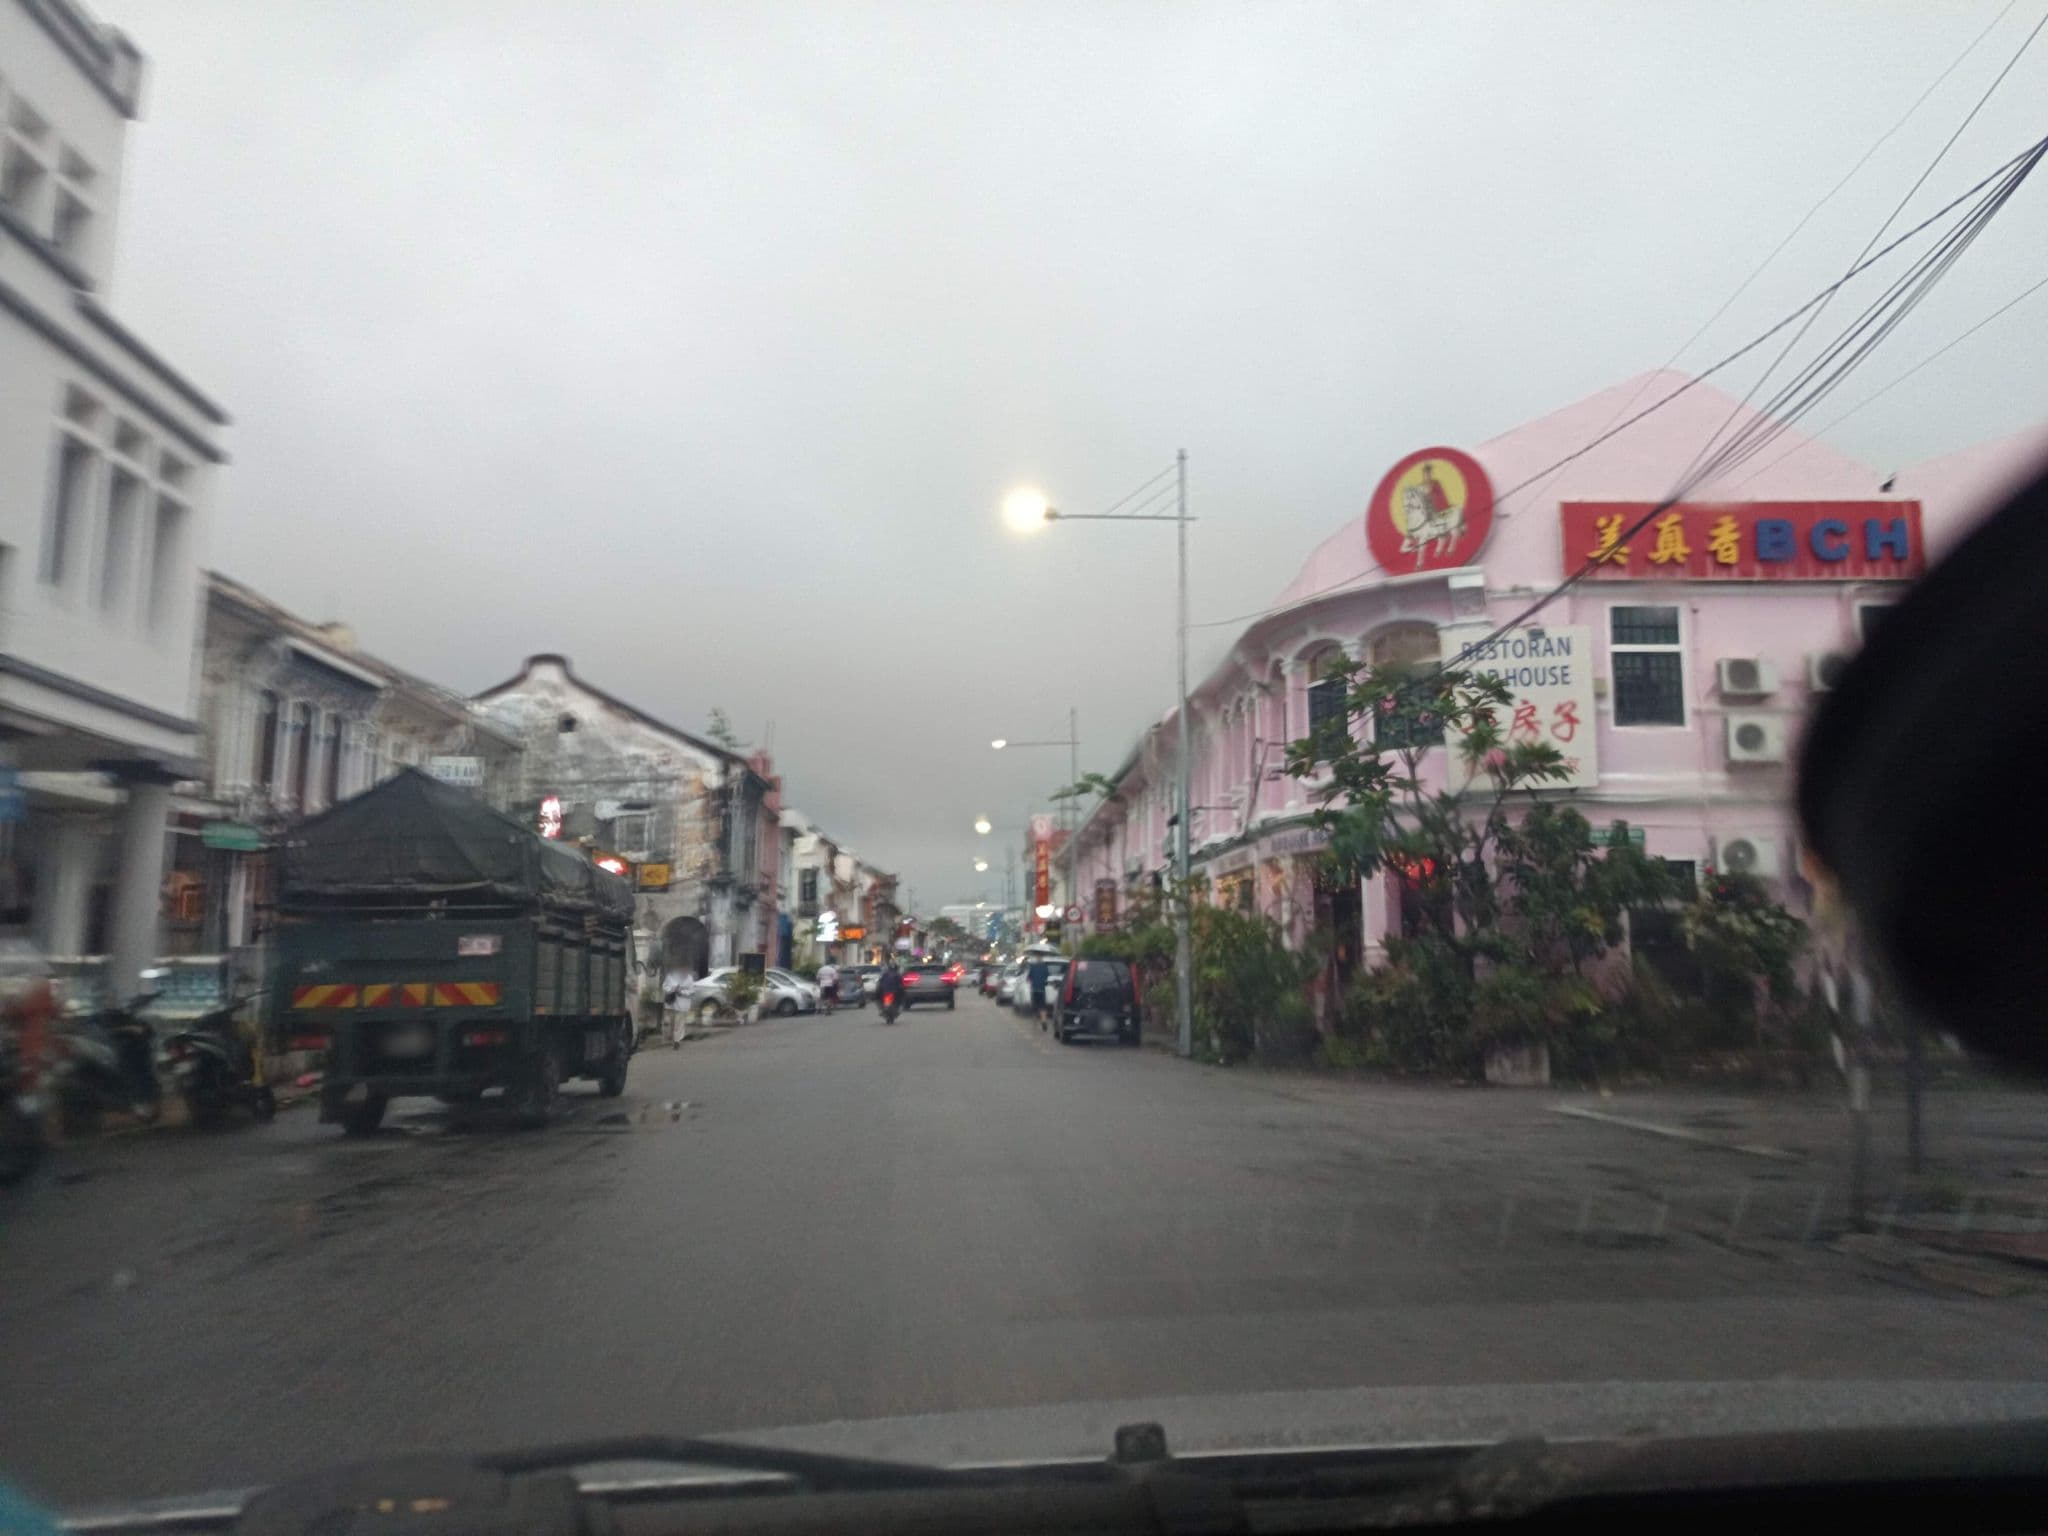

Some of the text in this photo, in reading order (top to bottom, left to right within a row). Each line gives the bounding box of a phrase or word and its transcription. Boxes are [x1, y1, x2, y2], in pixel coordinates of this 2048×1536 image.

[1587, 513, 1909, 565] 美真香 BCH
[1505, 665, 1571, 688] HOUSE
[1460, 699, 1580, 746] 房子
